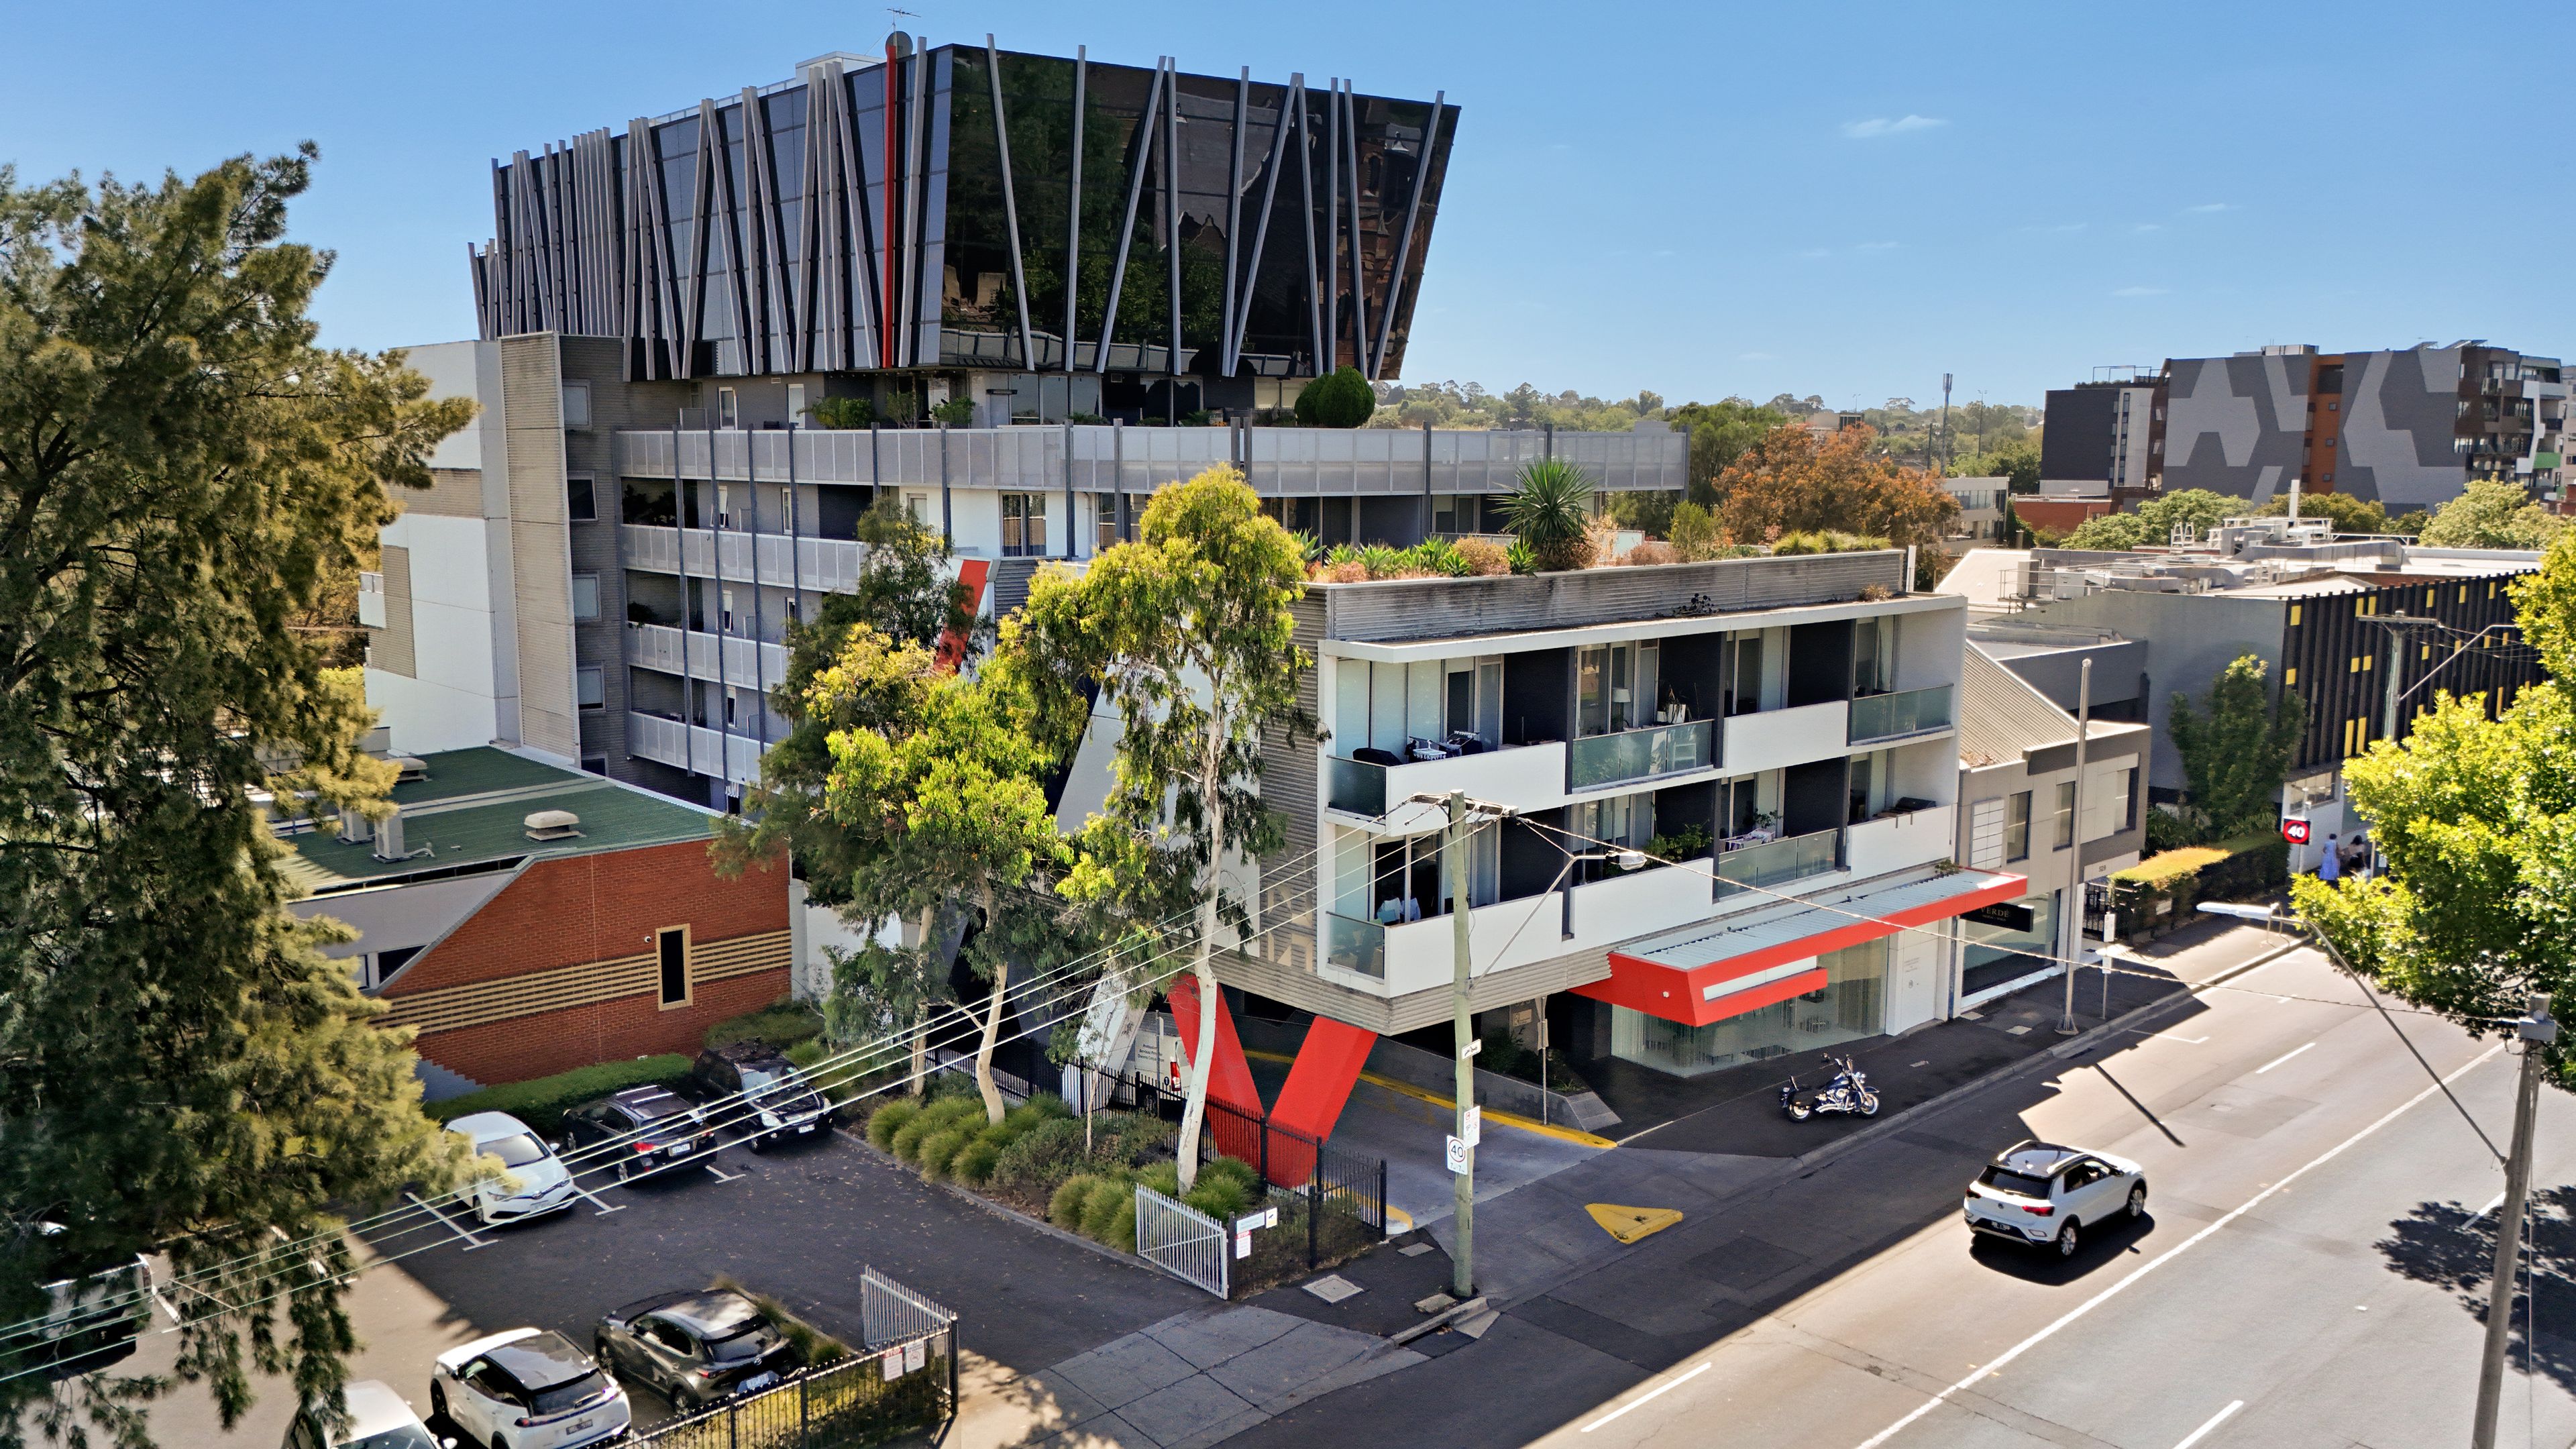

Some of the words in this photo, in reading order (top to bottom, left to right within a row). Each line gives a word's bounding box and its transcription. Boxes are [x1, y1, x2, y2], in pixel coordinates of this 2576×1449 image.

[2288, 825, 2305, 838] 40
[1451, 1144, 1464, 1158] 40
[885, 1347, 902, 1358] STOP
